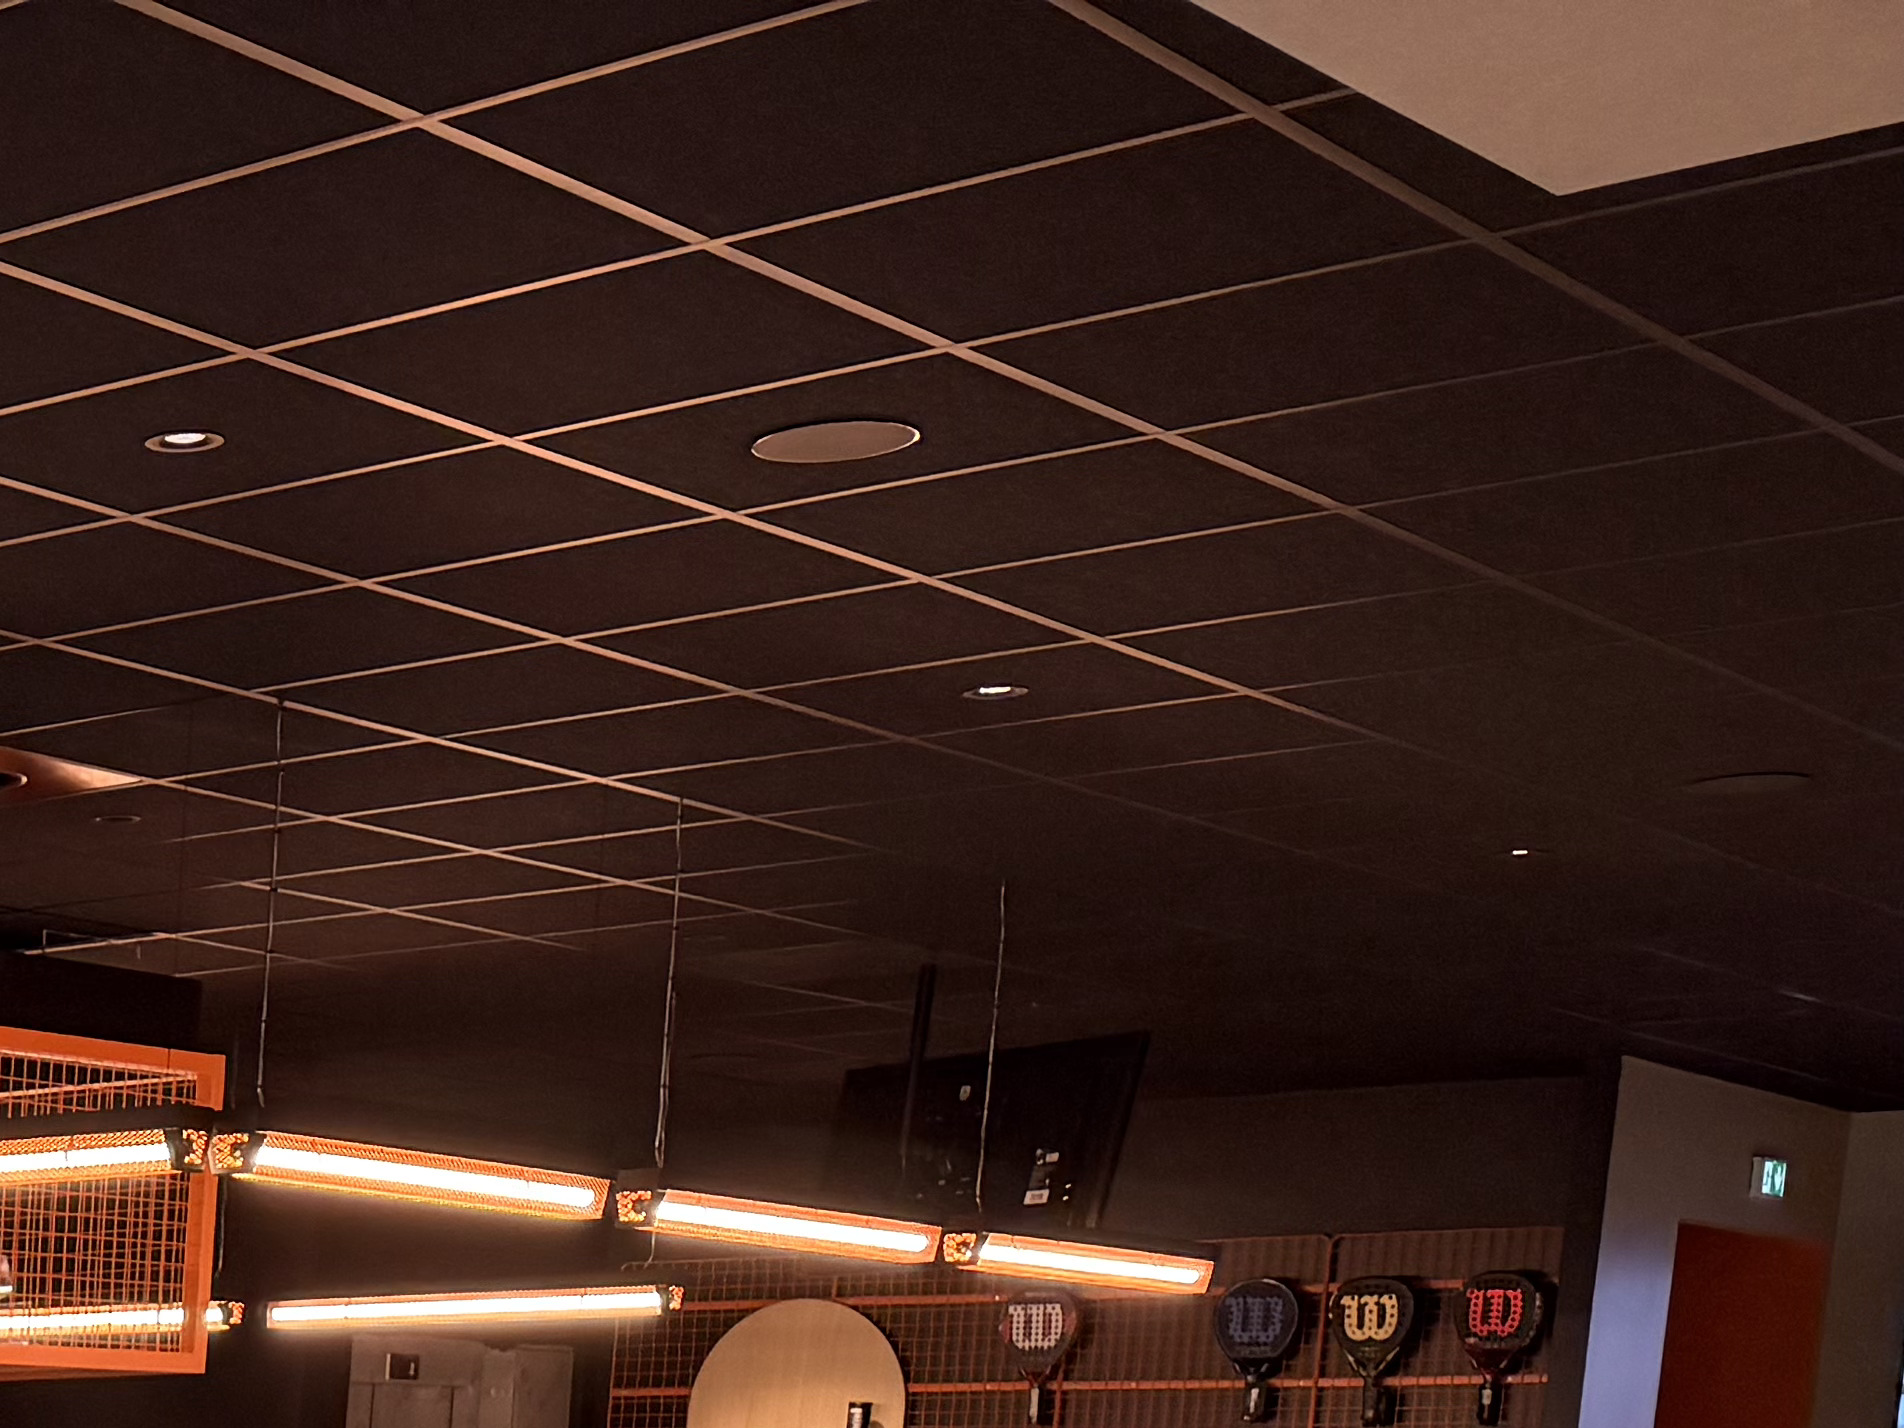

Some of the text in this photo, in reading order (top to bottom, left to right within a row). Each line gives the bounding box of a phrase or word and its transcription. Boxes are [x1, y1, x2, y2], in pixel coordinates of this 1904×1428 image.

[1225, 1295, 1284, 1343] W
[1340, 1293, 1398, 1341] W
[1467, 1288, 1523, 1338] W
